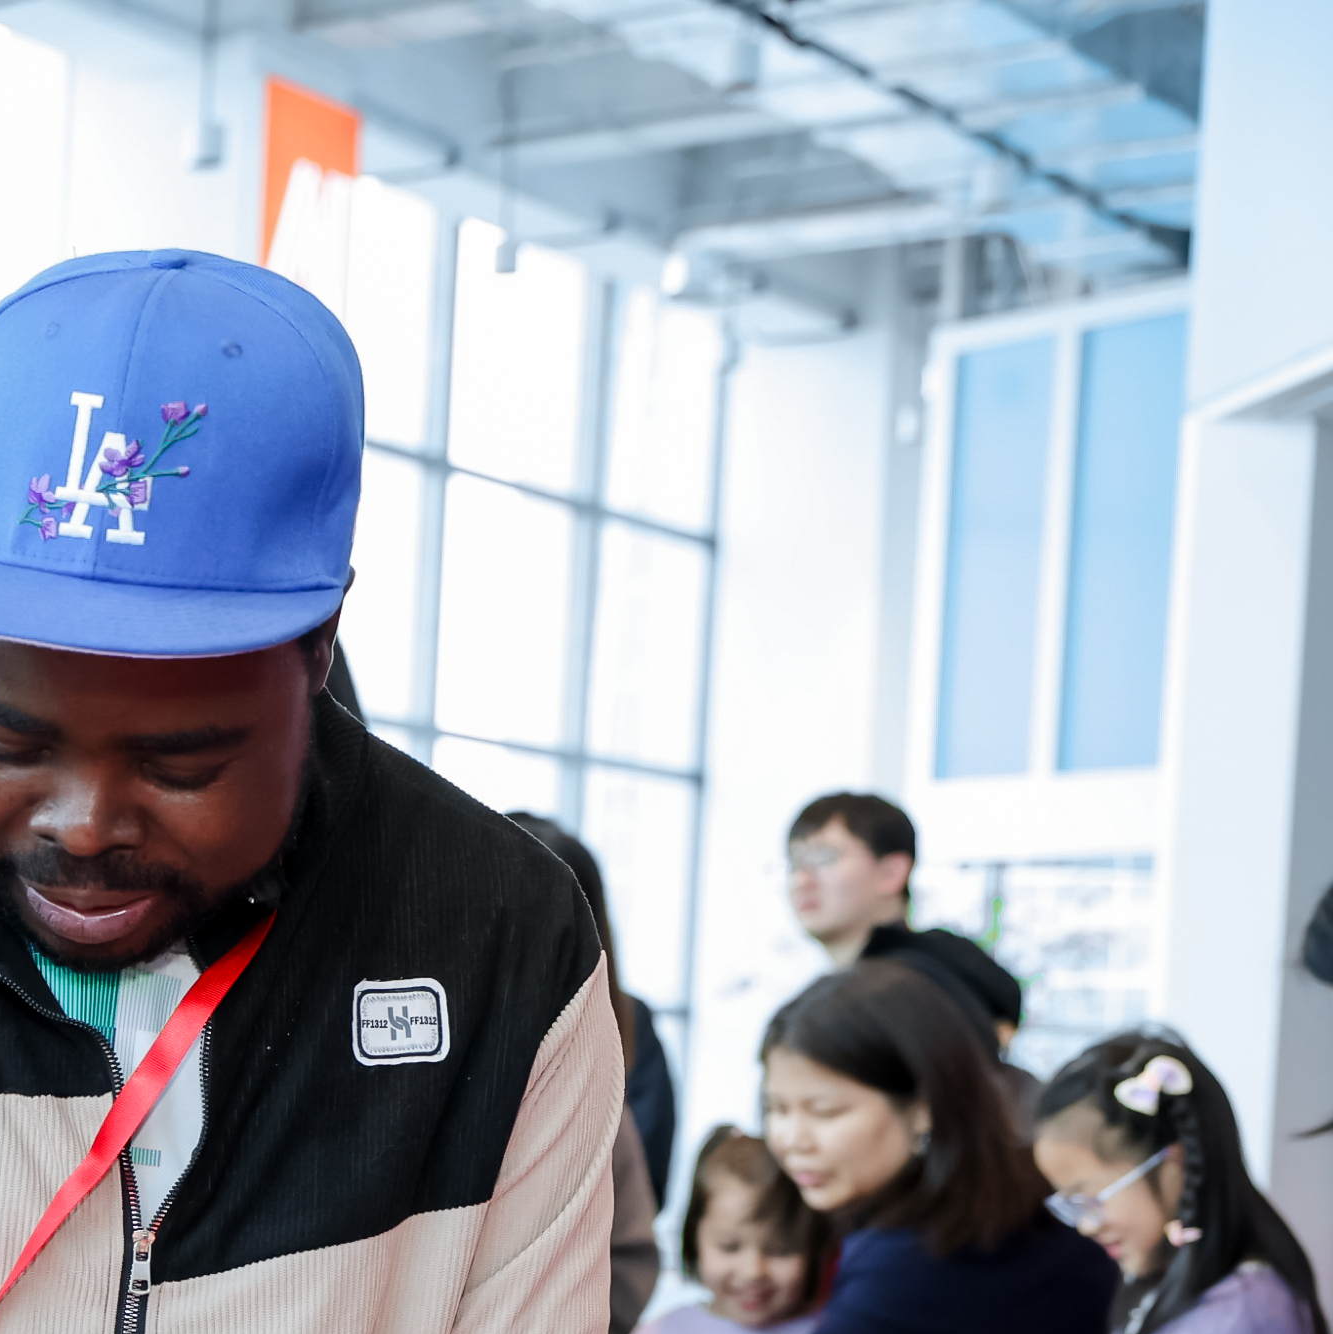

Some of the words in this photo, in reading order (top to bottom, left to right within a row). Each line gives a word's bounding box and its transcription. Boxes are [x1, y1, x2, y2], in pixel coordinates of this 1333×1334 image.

[54, 391, 154, 546] LA
[361, 1019, 389, 1029] FF1312
[409, 1015, 438, 1026] FF1312
